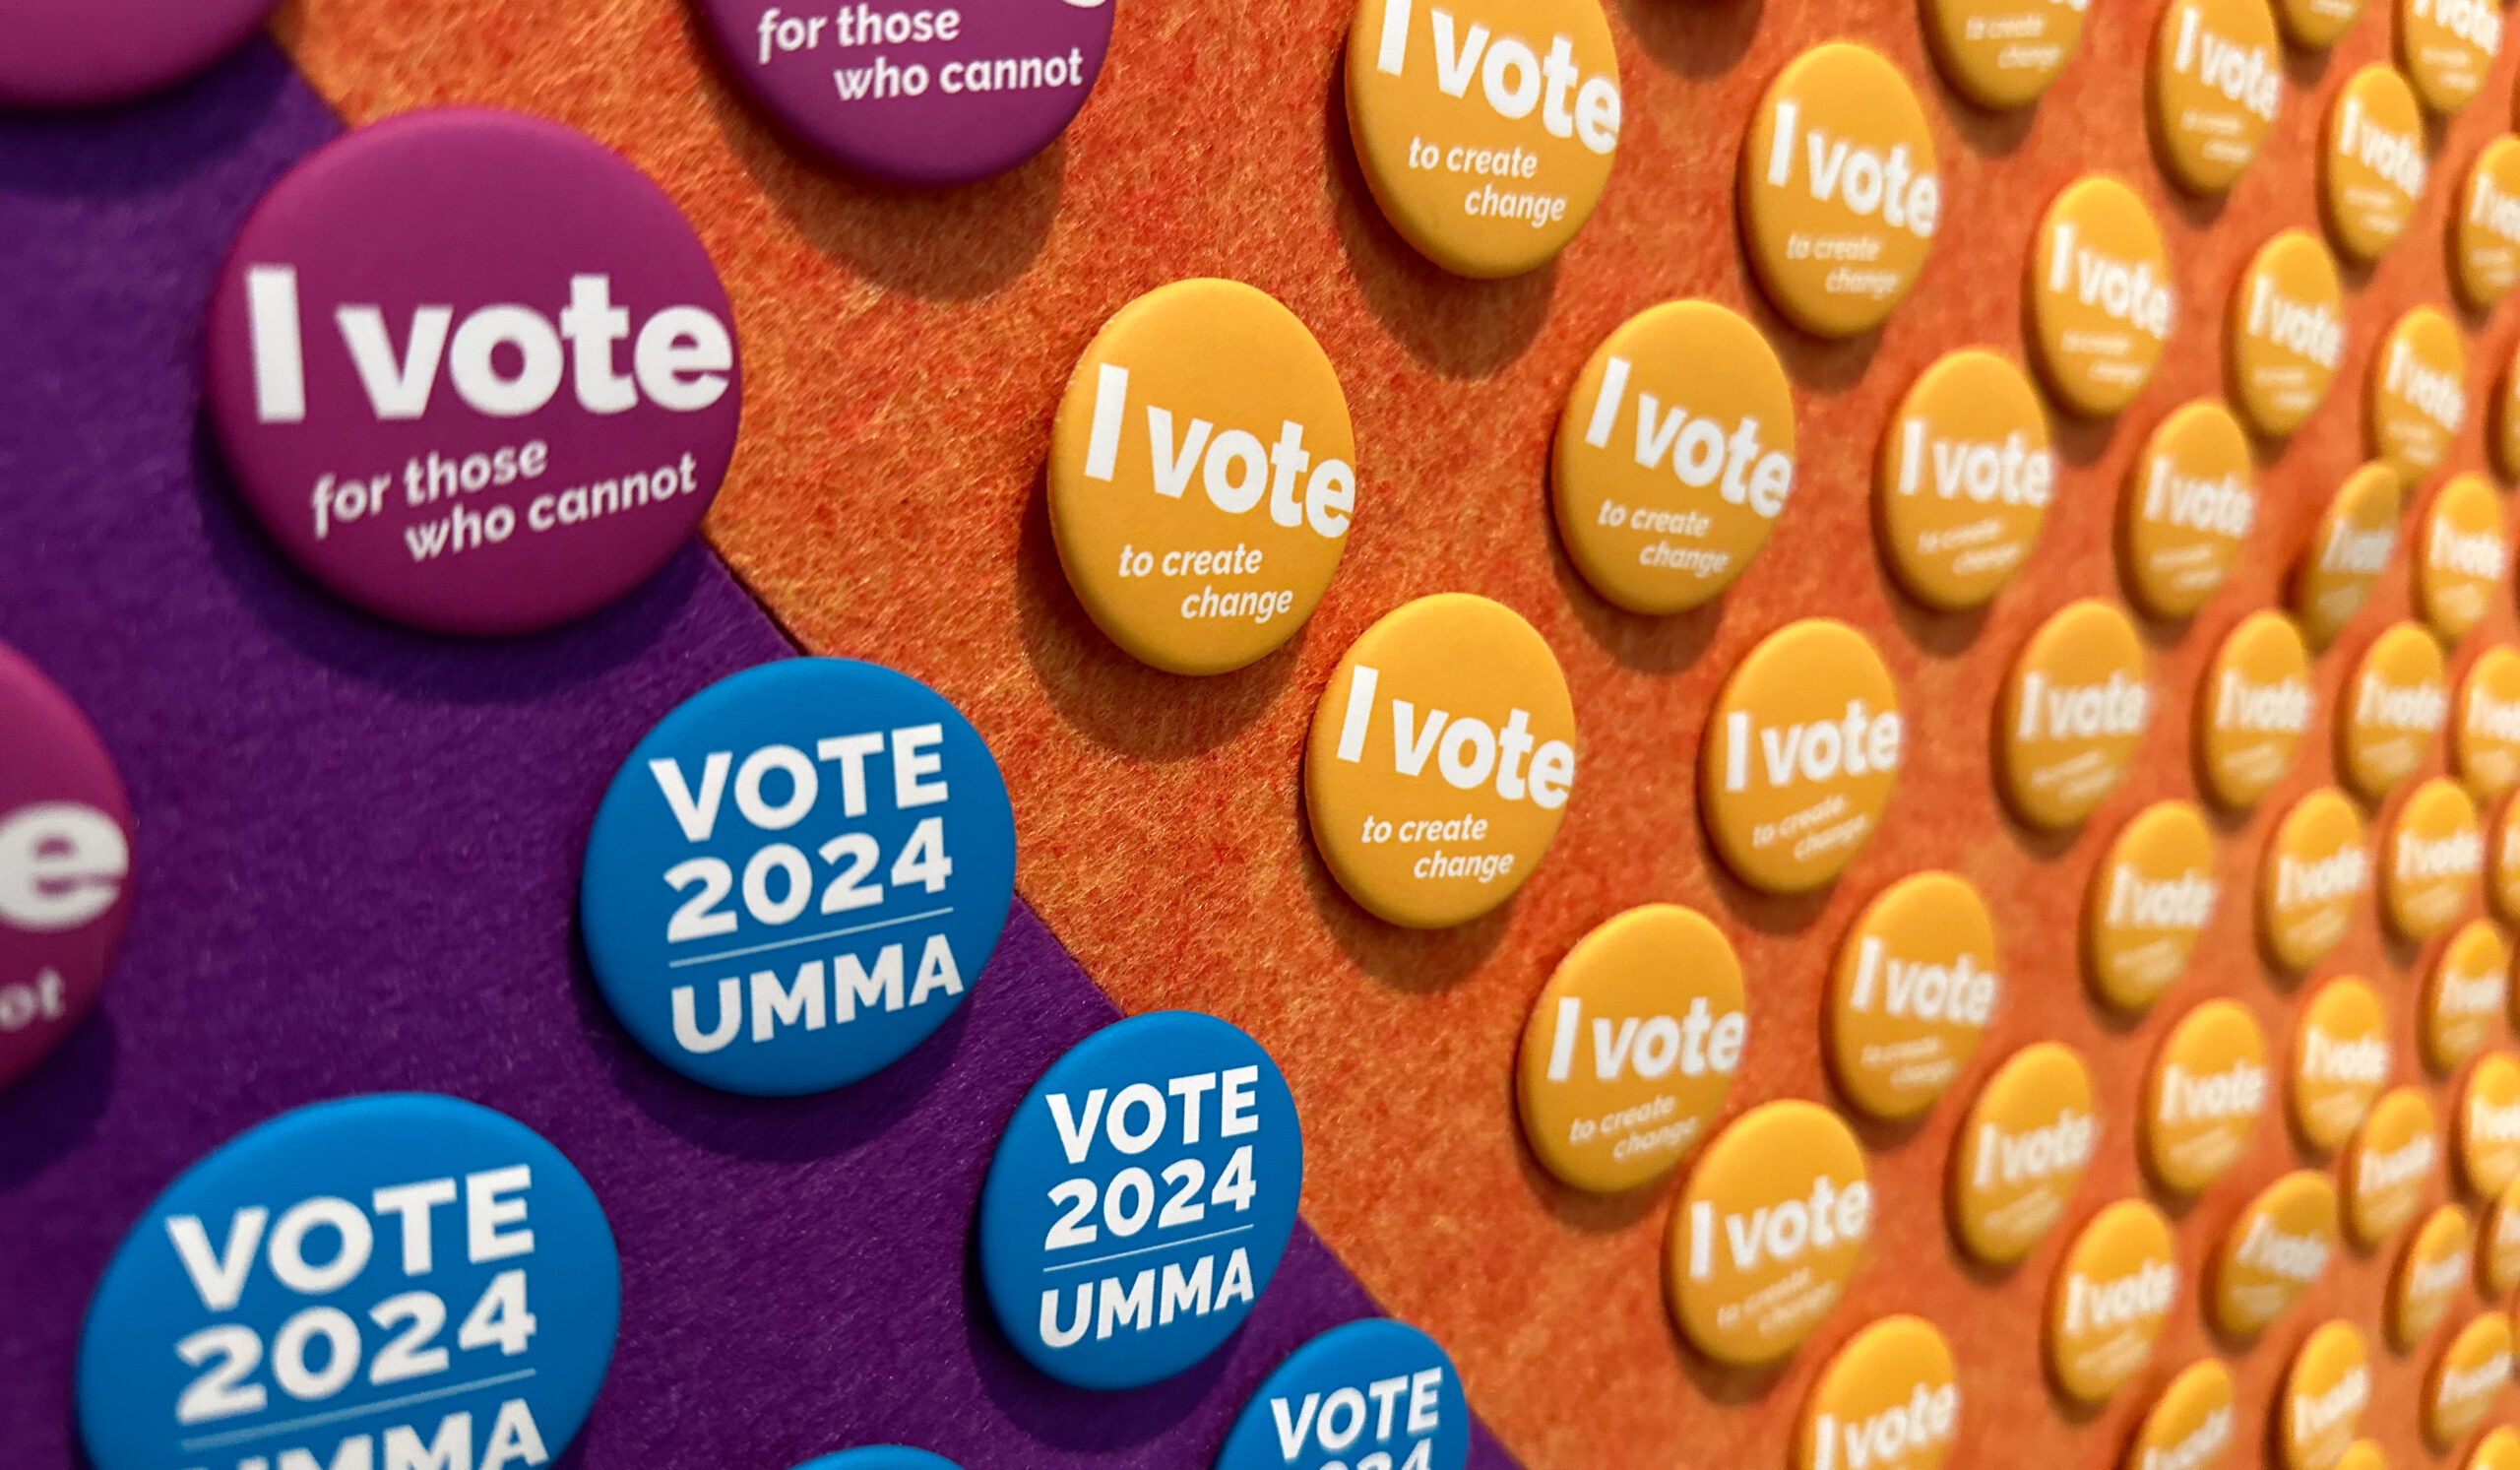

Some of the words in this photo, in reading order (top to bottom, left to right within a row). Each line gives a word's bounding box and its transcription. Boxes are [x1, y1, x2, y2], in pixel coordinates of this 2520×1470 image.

[758, 10, 826, 64] for
[836, 3, 960, 46] those
[835, 58, 928, 100] who
[938, 47, 1083, 93] cannot
[1431, 9, 1620, 155] vote
[2174, 6, 2199, 73] I
[2202, 32, 2280, 122] vote
[1409, 134, 1439, 169] to
[1446, 145, 1538, 178] create
[1465, 184, 1566, 228] change
[1767, 100, 1796, 187] I
[1807, 130, 1939, 237] vote
[2048, 222, 2077, 293] I
[2077, 247, 2173, 341] vote
[246, 264, 305, 423] I
[334, 274, 732, 417] vote
[1085, 363, 1129, 480] I
[1147, 405, 1355, 539] vote
[1585, 356, 1630, 449] I
[1635, 392, 1793, 518] vote
[1899, 418, 1925, 496] I
[1932, 430, 2053, 508] vote
[312, 469, 391, 539] for
[403, 440, 547, 504] those
[405, 501, 516, 561] who
[528, 452, 698, 533] cannot
[1598, 498, 1626, 528] to
[1630, 507, 1710, 538] create
[1118, 543, 1153, 577] to
[1161, 543, 1262, 576] create
[1180, 585, 1292, 624] change
[1639, 540, 1730, 579] change
[1337, 664, 1378, 763] I
[1392, 698, 1574, 808] vote
[1726, 710, 1749, 794] I
[1760, 697, 1901, 788] vote
[2019, 668, 2045, 742] I
[2048, 666, 2150, 739] vote
[649, 723, 949, 842] VOTE
[1361, 814, 1392, 844] to
[1399, 813, 1487, 843] create
[664, 816, 952, 942] 2024
[1414, 850, 1514, 883] change
[671, 933, 964, 1054] UMMA
[1850, 935, 1882, 1012] I
[1886, 953, 1998, 1028] vote
[1547, 996, 1581, 1083] I
[1592, 996, 1746, 1080] vote
[1044, 1064, 1260, 1166] VOTE
[164, 1163, 536, 1312] VOTE
[1043, 1144, 1256, 1252] 2024
[1689, 1200, 1713, 1280] I
[1725, 1175, 1870, 1271] vote
[174, 1269, 536, 1426] 2024
[1038, 1246, 1256, 1349] UMMA
[1270, 1366, 1442, 1462] VOTE
